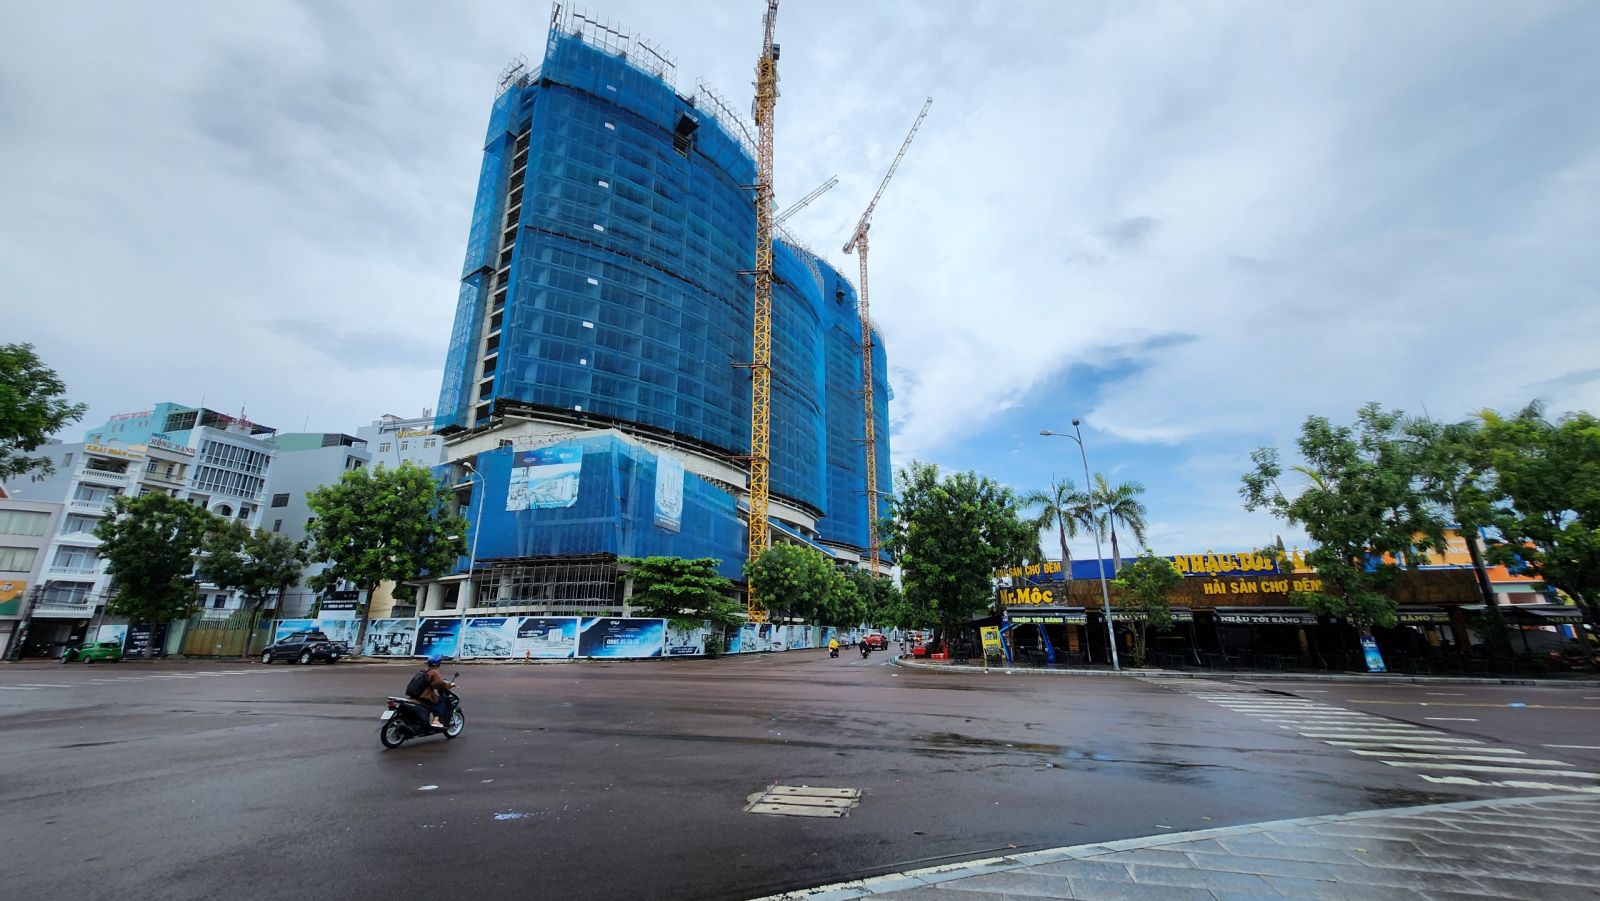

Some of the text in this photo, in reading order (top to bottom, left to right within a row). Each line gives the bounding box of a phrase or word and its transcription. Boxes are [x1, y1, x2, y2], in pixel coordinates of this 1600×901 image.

[1009, 563, 1022, 578] SẢN
[1025, 563, 1040, 576] CHỢ
[1043, 561, 1062, 573] ĐÊM
[1175, 549, 1234, 576] NHẬU
[1203, 578, 1226, 594] HẢI
[1231, 577, 1257, 593] SẢN
[1261, 578, 1288, 594] CHỢ
[1220, 615, 1249, 623] NHẬU
